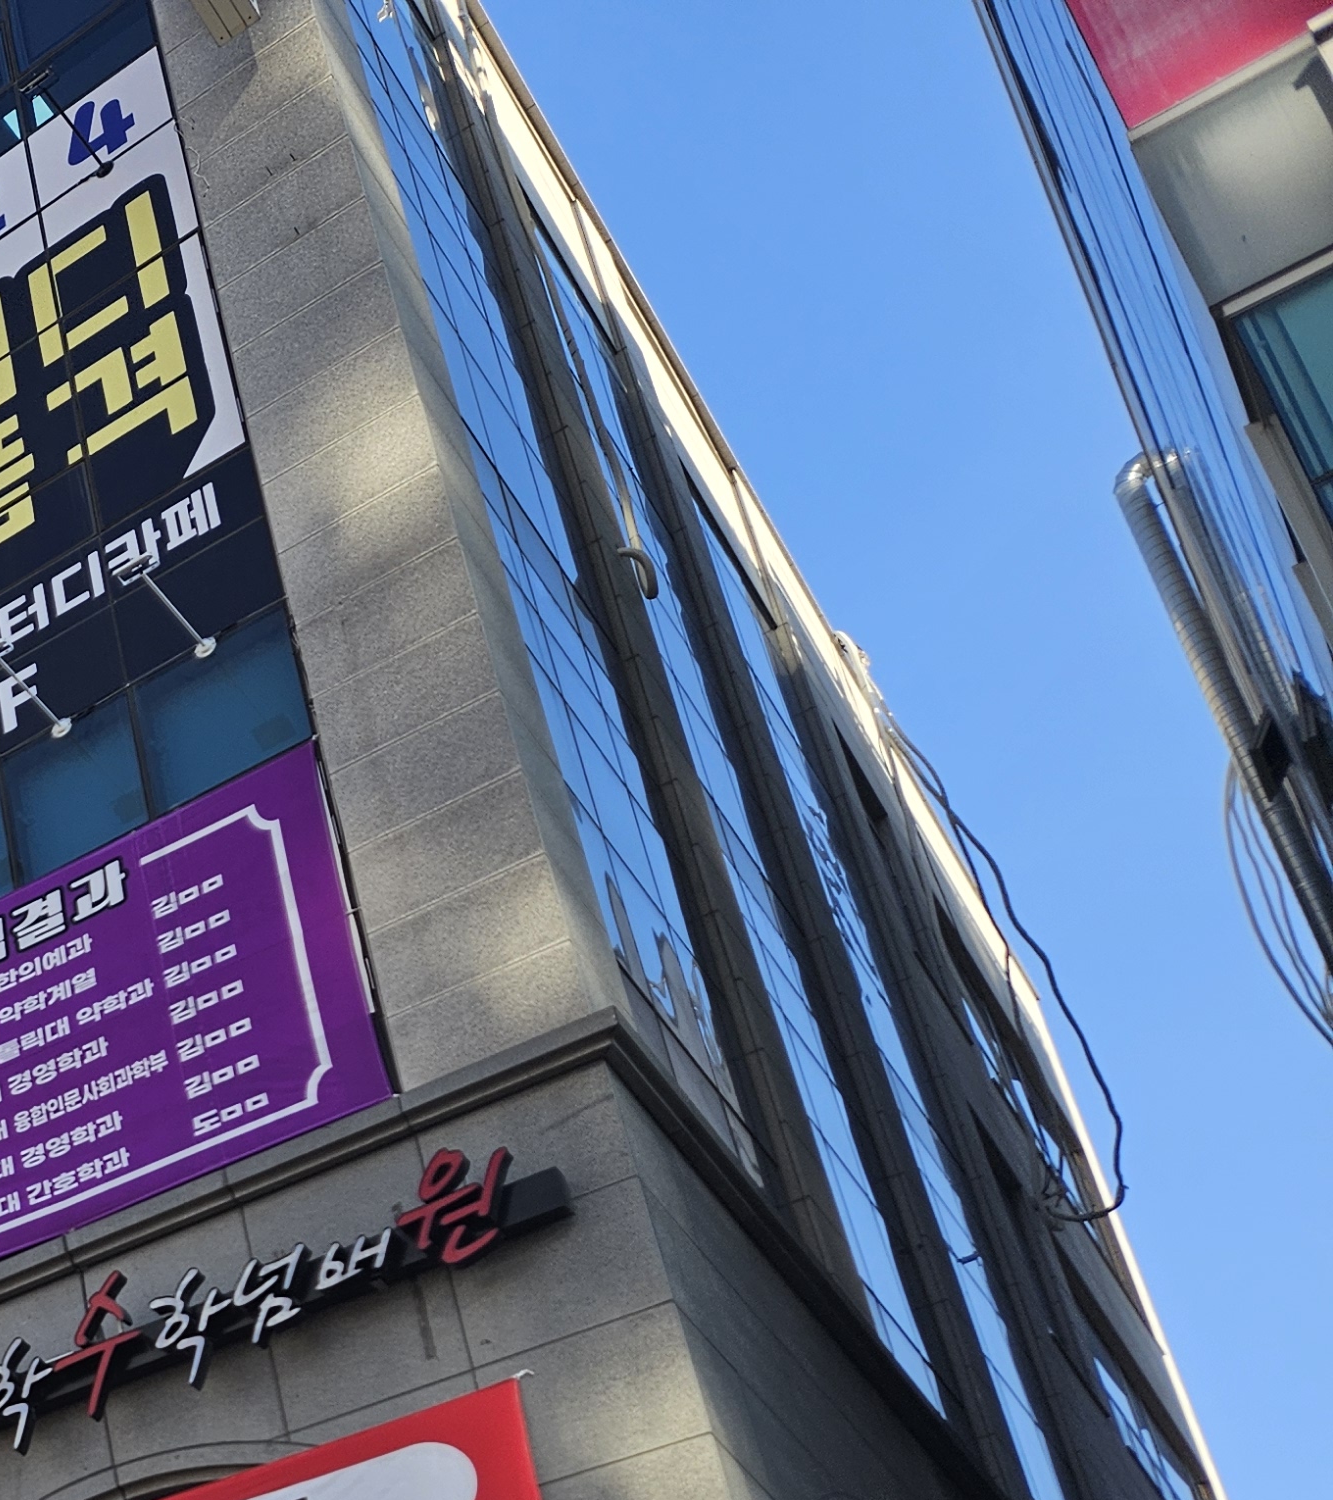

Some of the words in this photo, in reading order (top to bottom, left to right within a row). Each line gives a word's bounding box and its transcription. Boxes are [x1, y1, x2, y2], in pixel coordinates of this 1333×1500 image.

[76, 977, 156, 1029] 약학과
[7, 1035, 110, 1097] 경영학과
[12, 1047, 170, 1134] 융합인문사회과학부
[19, 1109, 124, 1172] 경영학과
[25, 1146, 132, 1210] 간호학과
